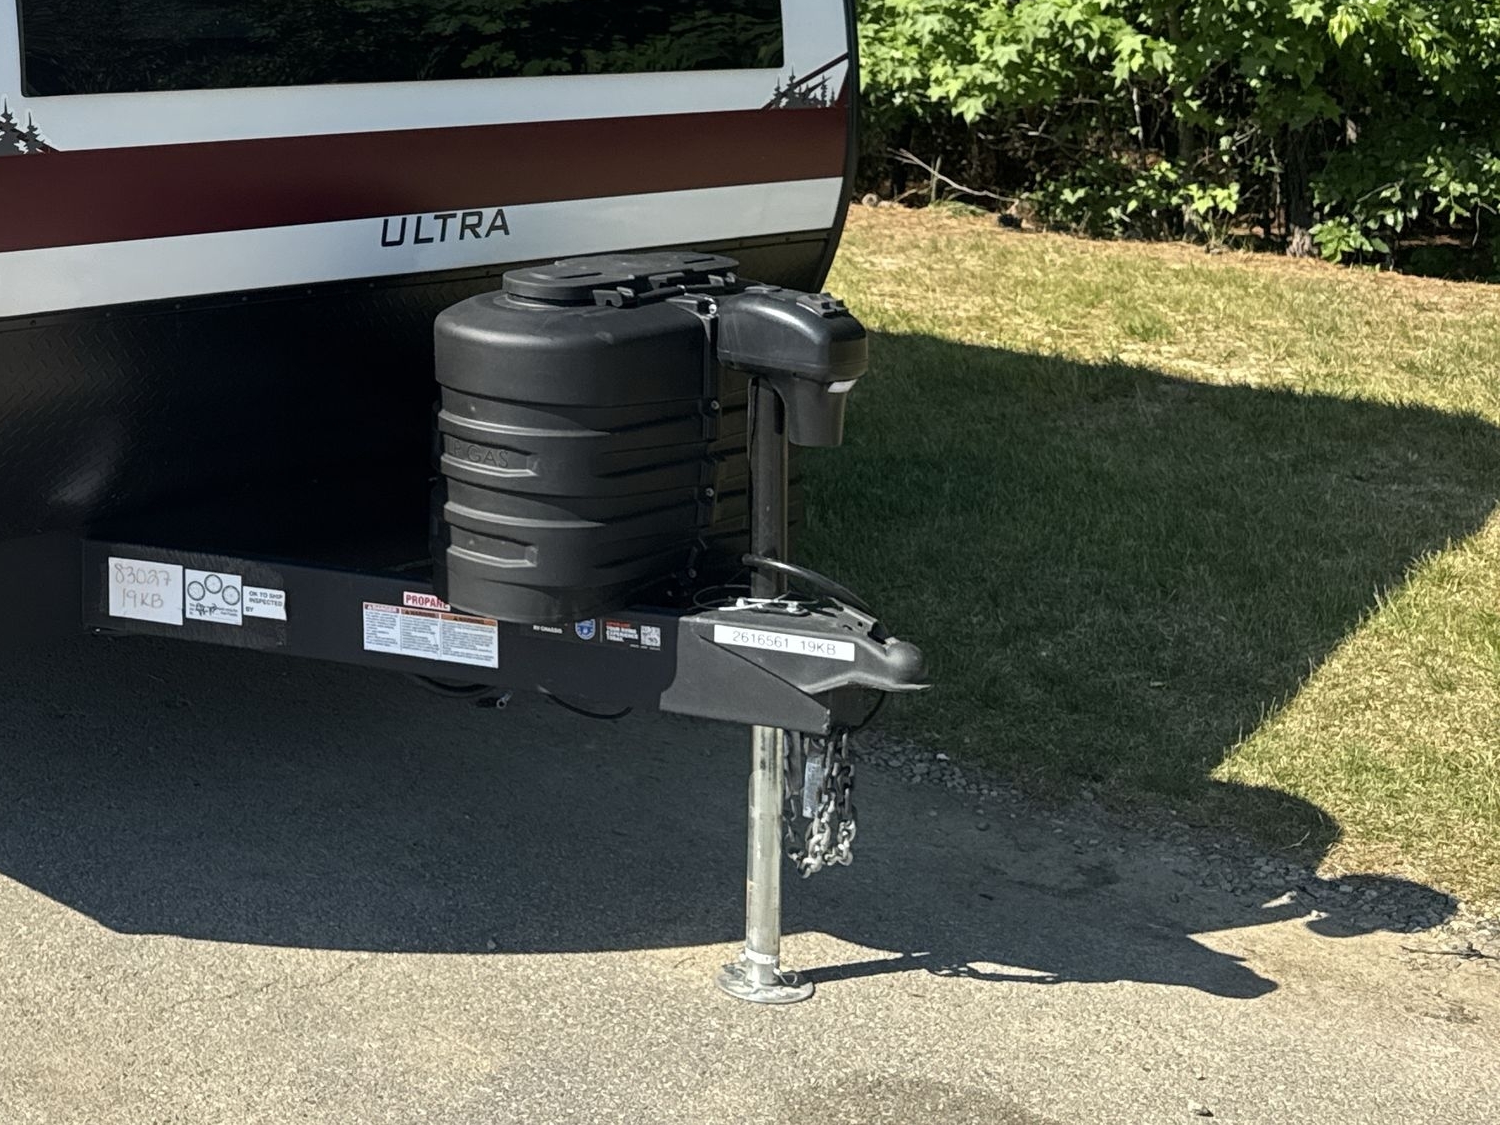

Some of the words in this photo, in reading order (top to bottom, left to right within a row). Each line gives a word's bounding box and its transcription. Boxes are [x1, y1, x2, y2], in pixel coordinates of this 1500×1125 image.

[381, 208, 510, 247] ULTRA
[466, 444, 509, 468] GAS
[121, 588, 164, 609] 19KB
[248, 597, 283, 607] INSPECTED
[732, 630, 789, 648] 2616561
[800, 640, 836, 655] 19KB
